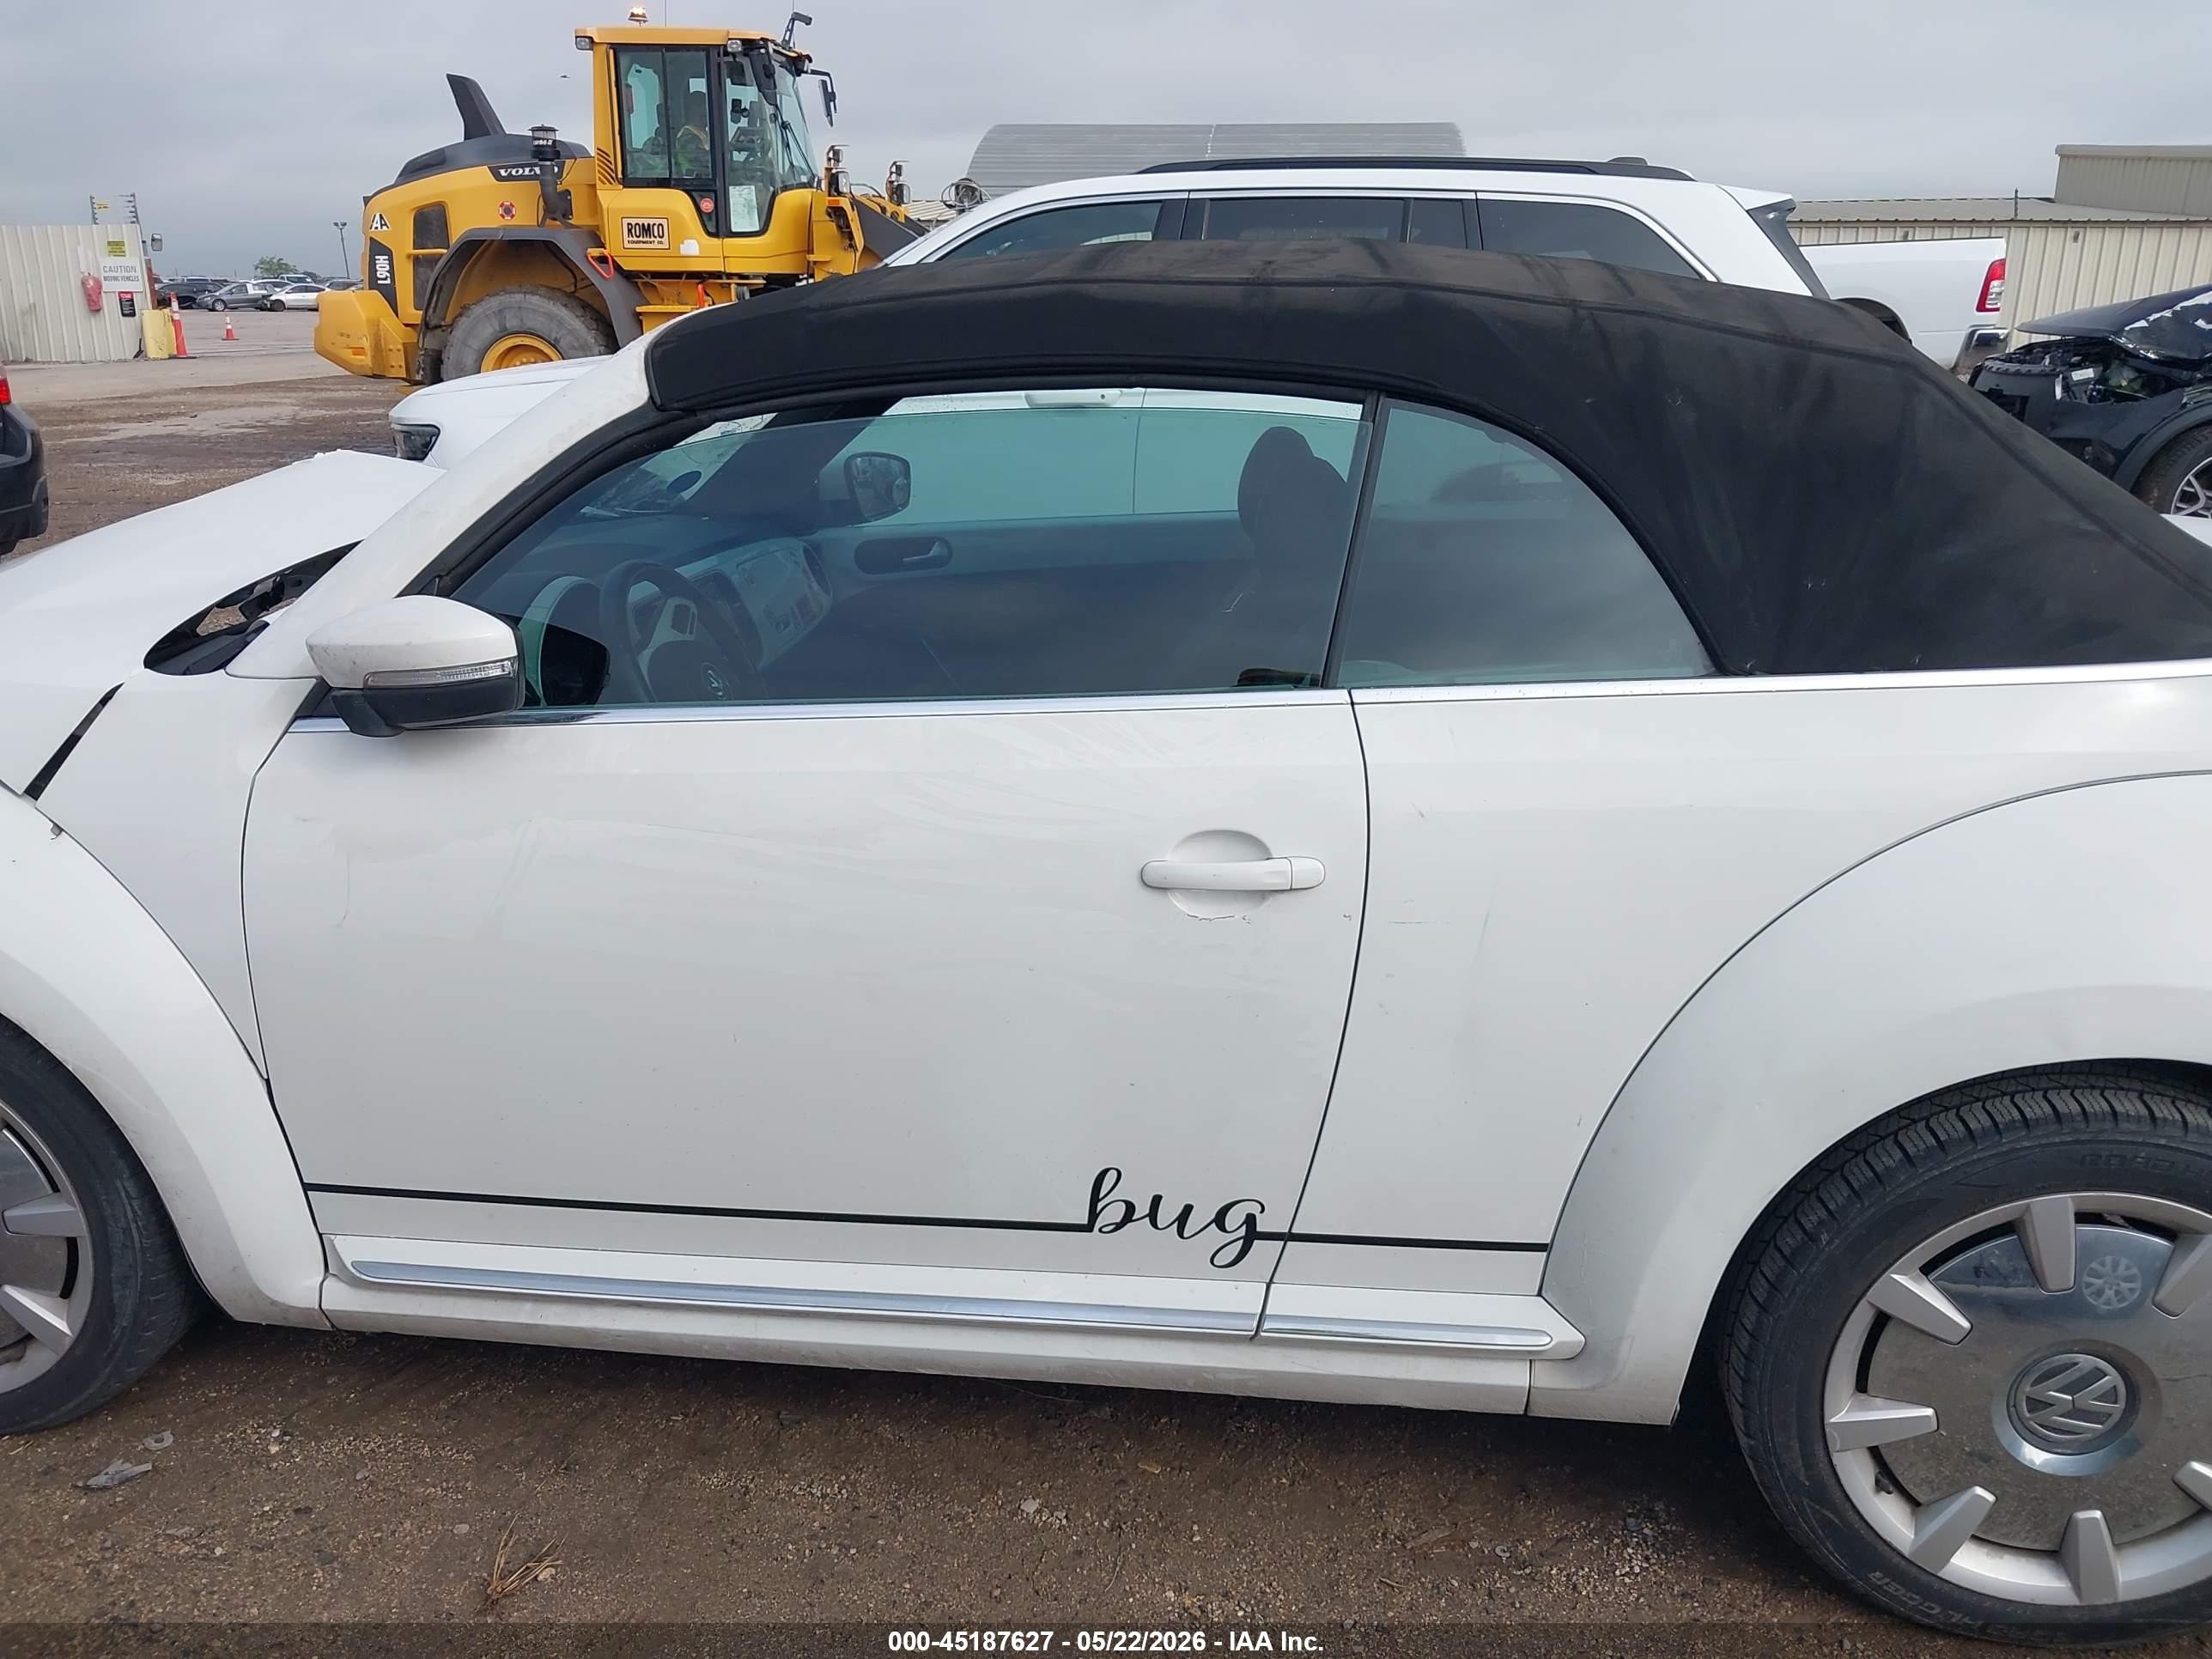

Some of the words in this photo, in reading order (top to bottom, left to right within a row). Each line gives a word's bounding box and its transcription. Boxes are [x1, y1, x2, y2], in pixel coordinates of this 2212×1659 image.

[627, 222, 665, 239] ROMCO
[103, 265, 137, 274] CAUTION
[374, 255, 392, 284] L90H
[1086, 1167, 1266, 1269] bug
